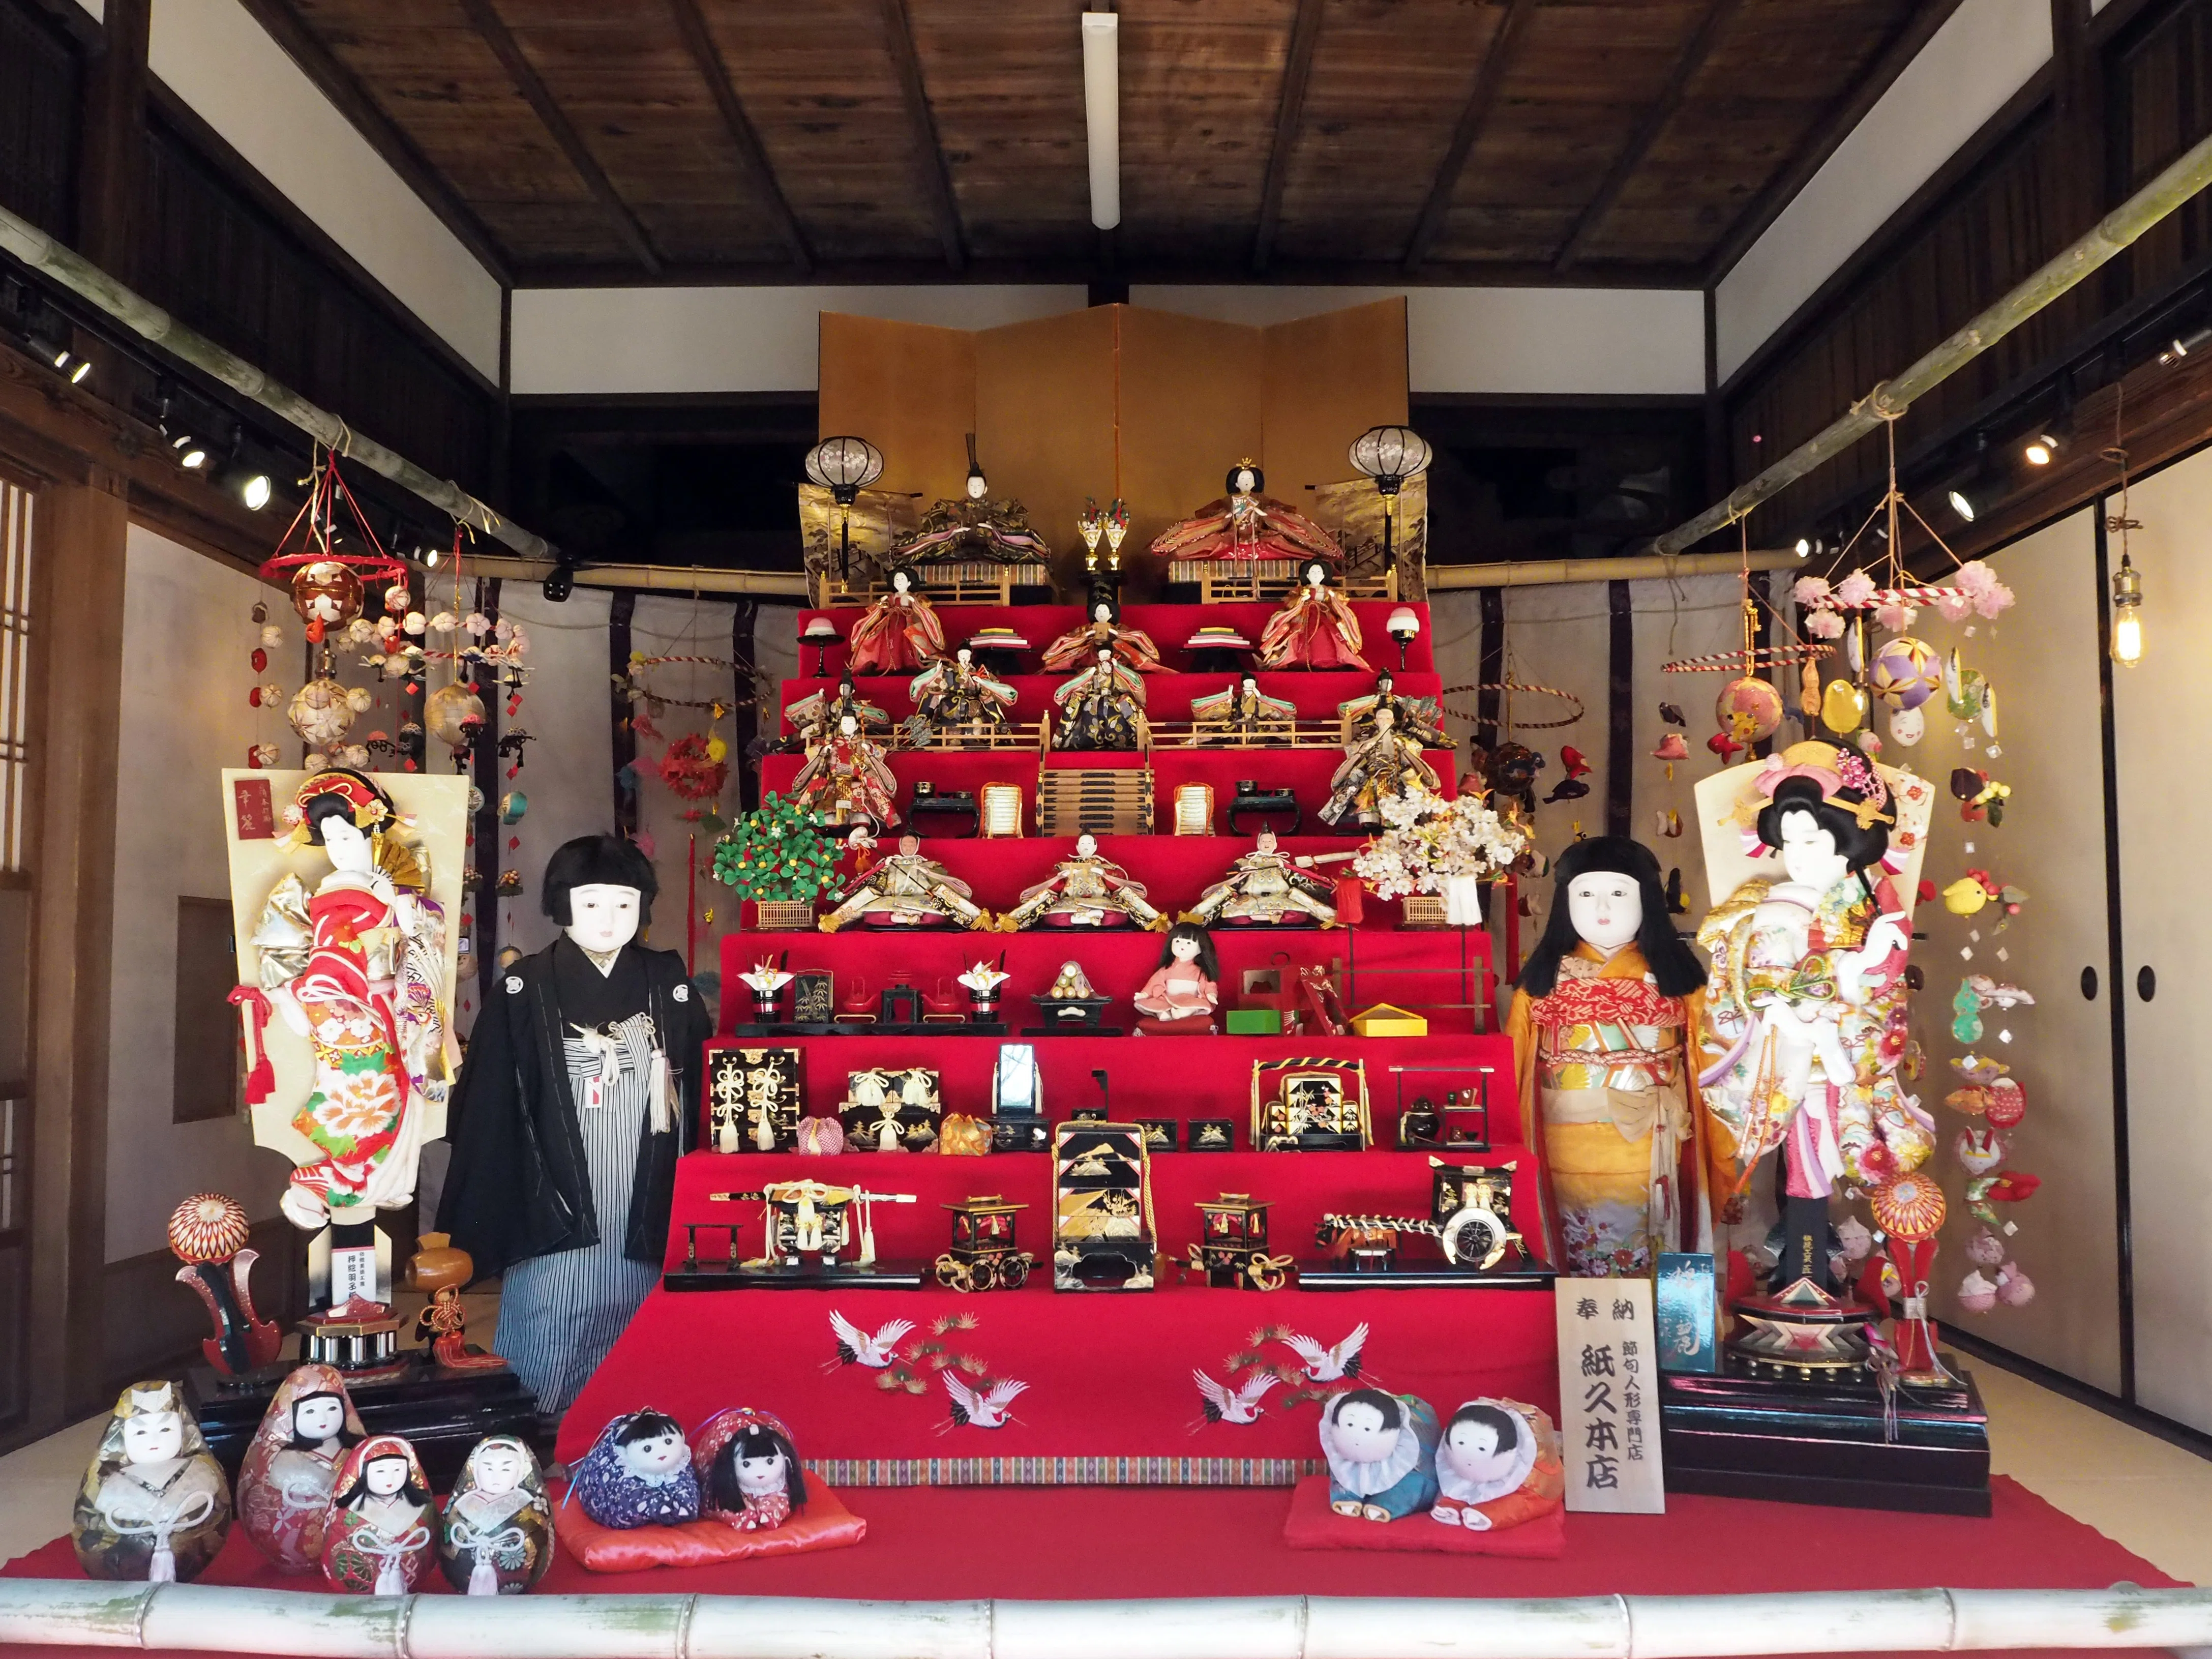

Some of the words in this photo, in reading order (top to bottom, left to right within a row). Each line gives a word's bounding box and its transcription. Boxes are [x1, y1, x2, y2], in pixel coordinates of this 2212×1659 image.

[1576, 1297, 1635, 1321] 奉納
[1580, 1344, 1619, 1490] 紙久本店
[1622, 1341, 1643, 1461] 節句人形専門店
